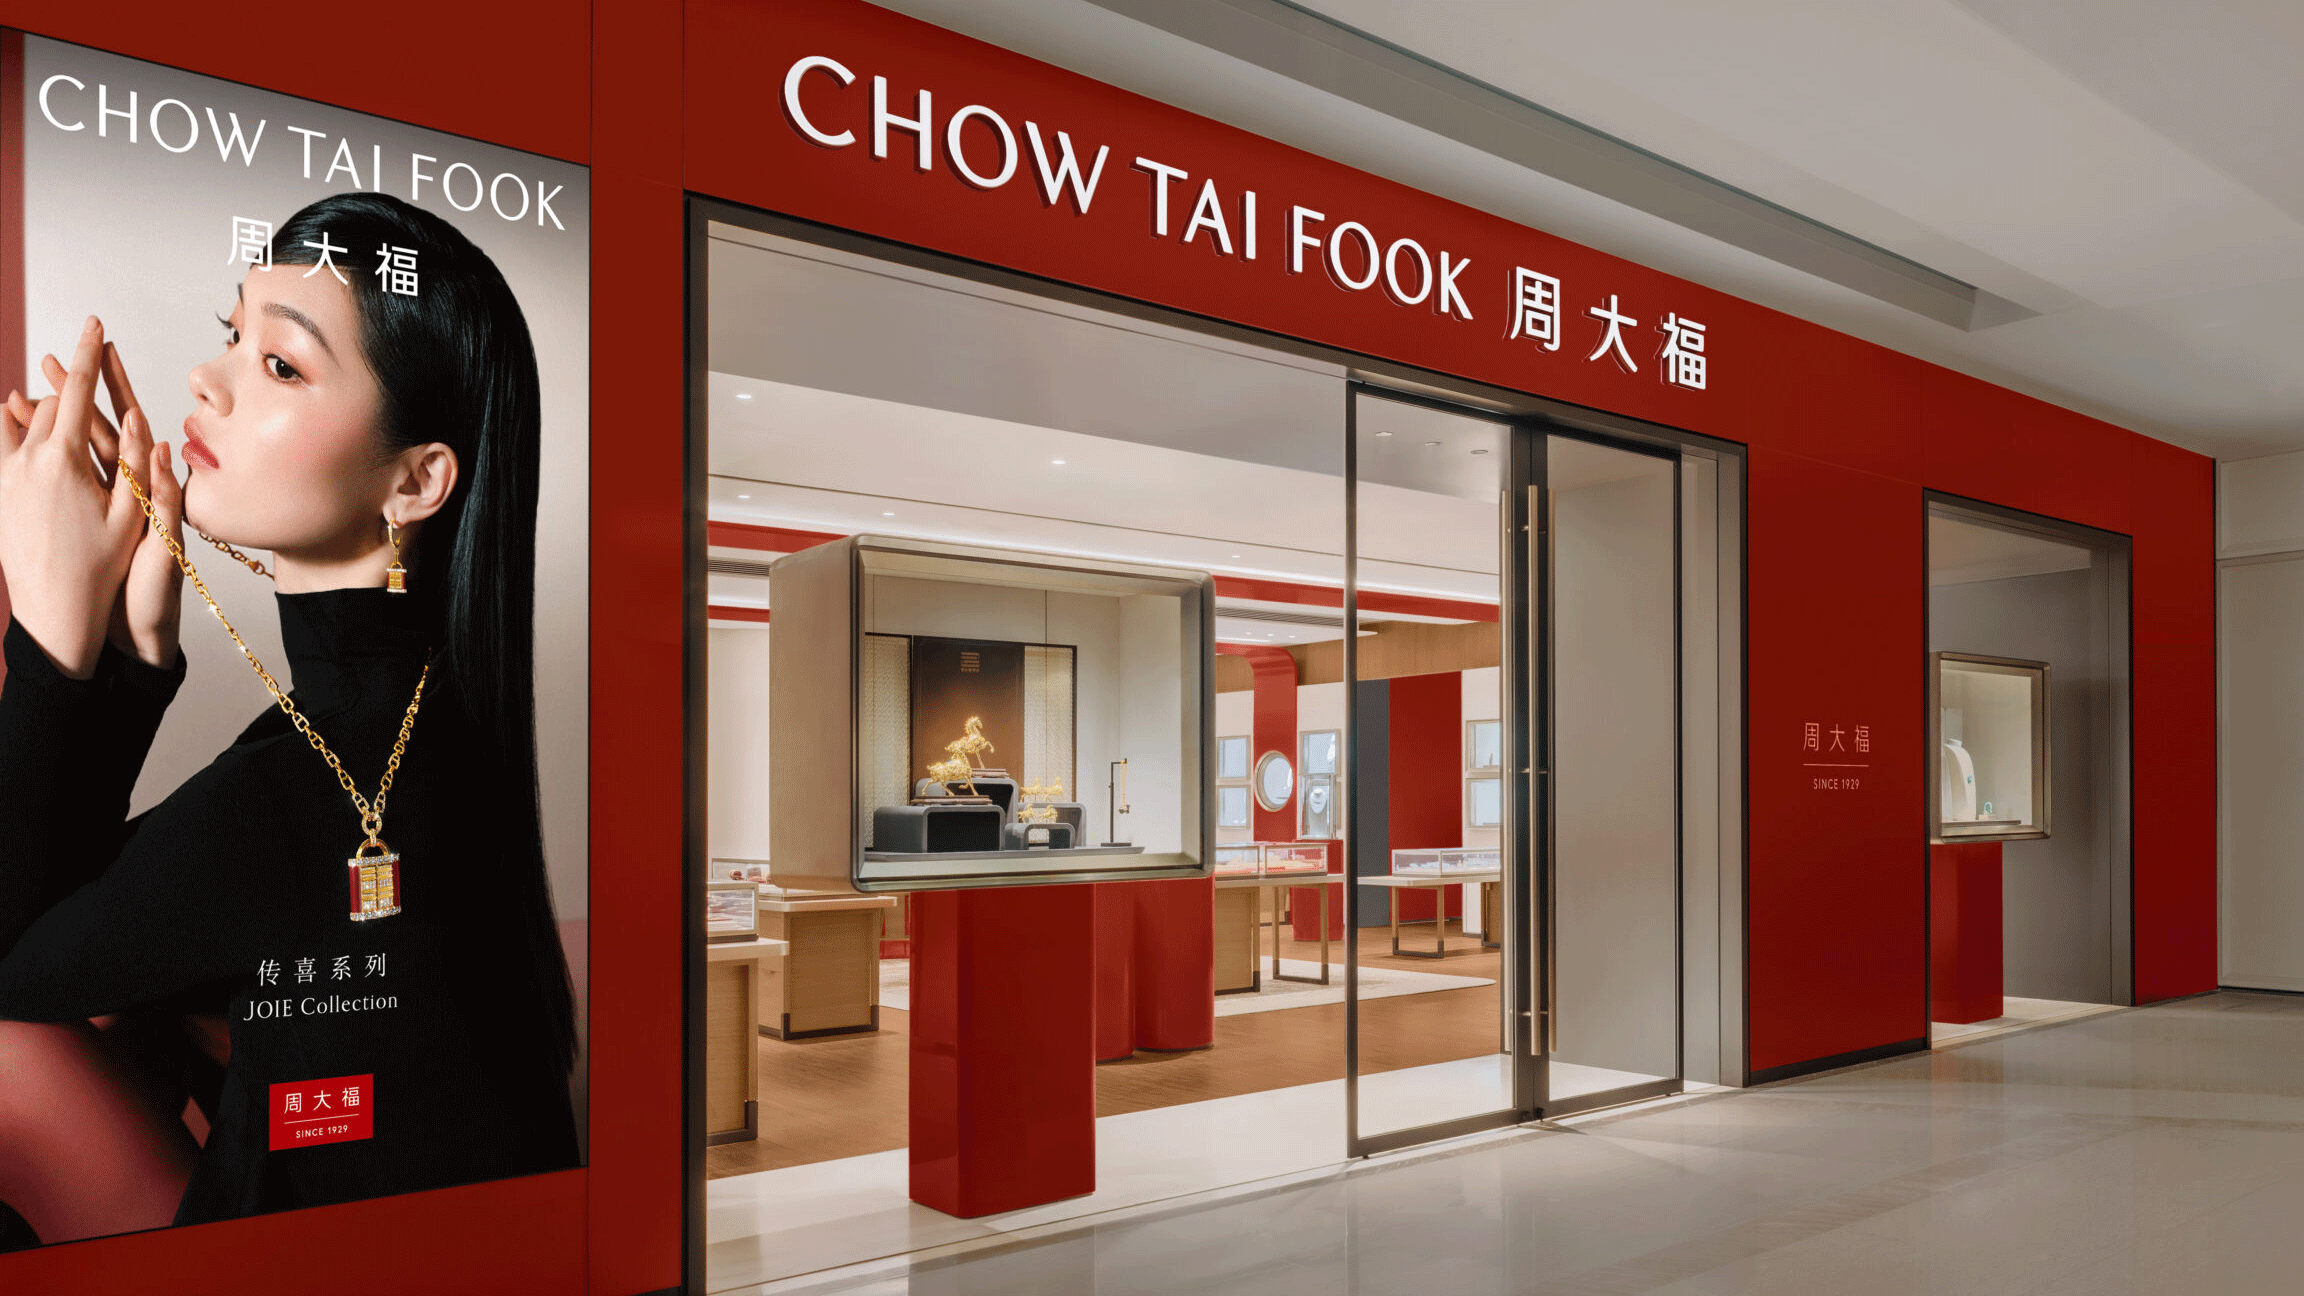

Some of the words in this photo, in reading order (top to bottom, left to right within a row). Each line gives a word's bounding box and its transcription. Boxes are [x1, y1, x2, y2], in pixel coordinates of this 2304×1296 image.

[38, 74, 267, 167] CHOW
[287, 125, 380, 193] TAI
[410, 153, 566, 231] FOOK
[783, 55, 1109, 215] CHOW
[1135, 156, 1257, 260] TAI
[1292, 205, 1474, 321] FOOK
[227, 216, 420, 297] 周大福
[1509, 265, 1707, 391] 周大福
[1803, 722, 1870, 753] 周大福
[1813, 778, 1839, 790] SINCE
[1841, 778, 1860, 790] 1929
[256, 952, 387, 987] 传喜系列
[243, 998, 293, 1021] JOIE
[300, 994, 398, 1016] Collection
[283, 1086, 361, 1115] 周大福
[295, 1127, 324, 1139] SINCE
[327, 1124, 349, 1135] 1929
